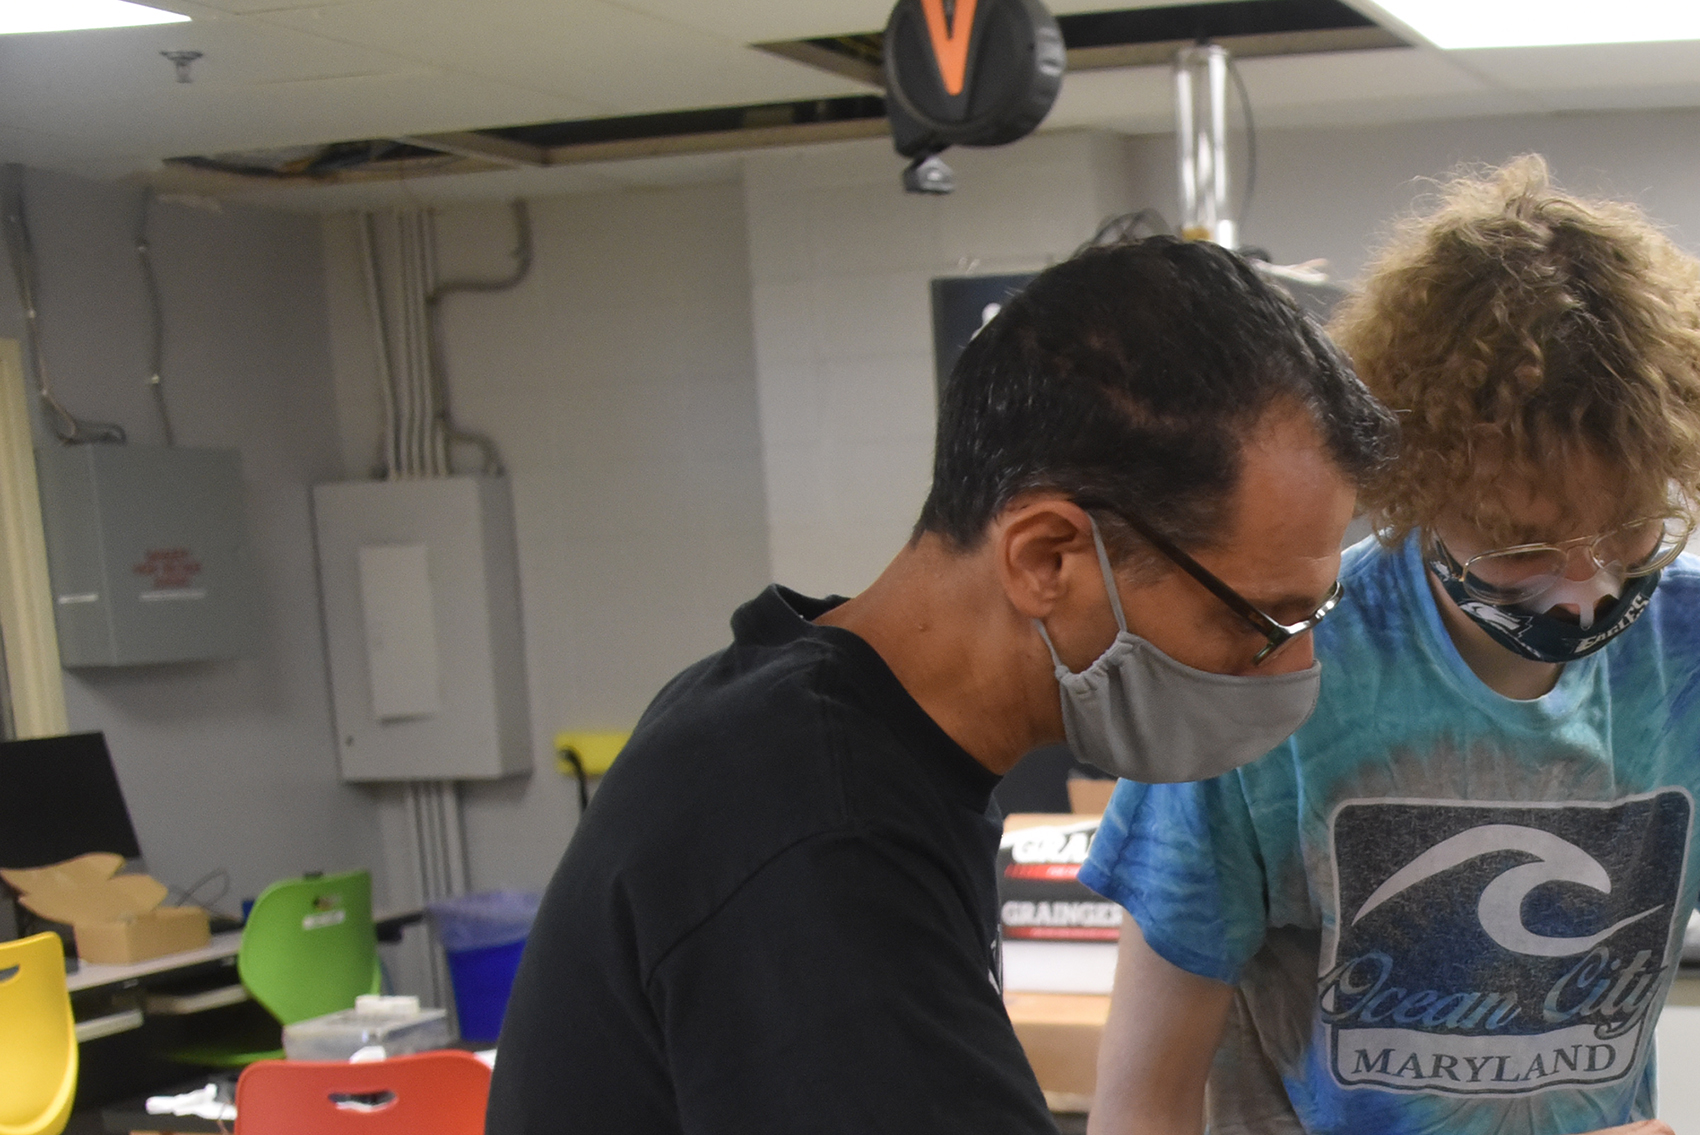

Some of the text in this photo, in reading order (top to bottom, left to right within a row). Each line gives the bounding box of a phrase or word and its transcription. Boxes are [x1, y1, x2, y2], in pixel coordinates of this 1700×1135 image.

[1319, 947, 1667, 1040] Ocean City
[1351, 1044, 1617, 1083] MARYLAND
